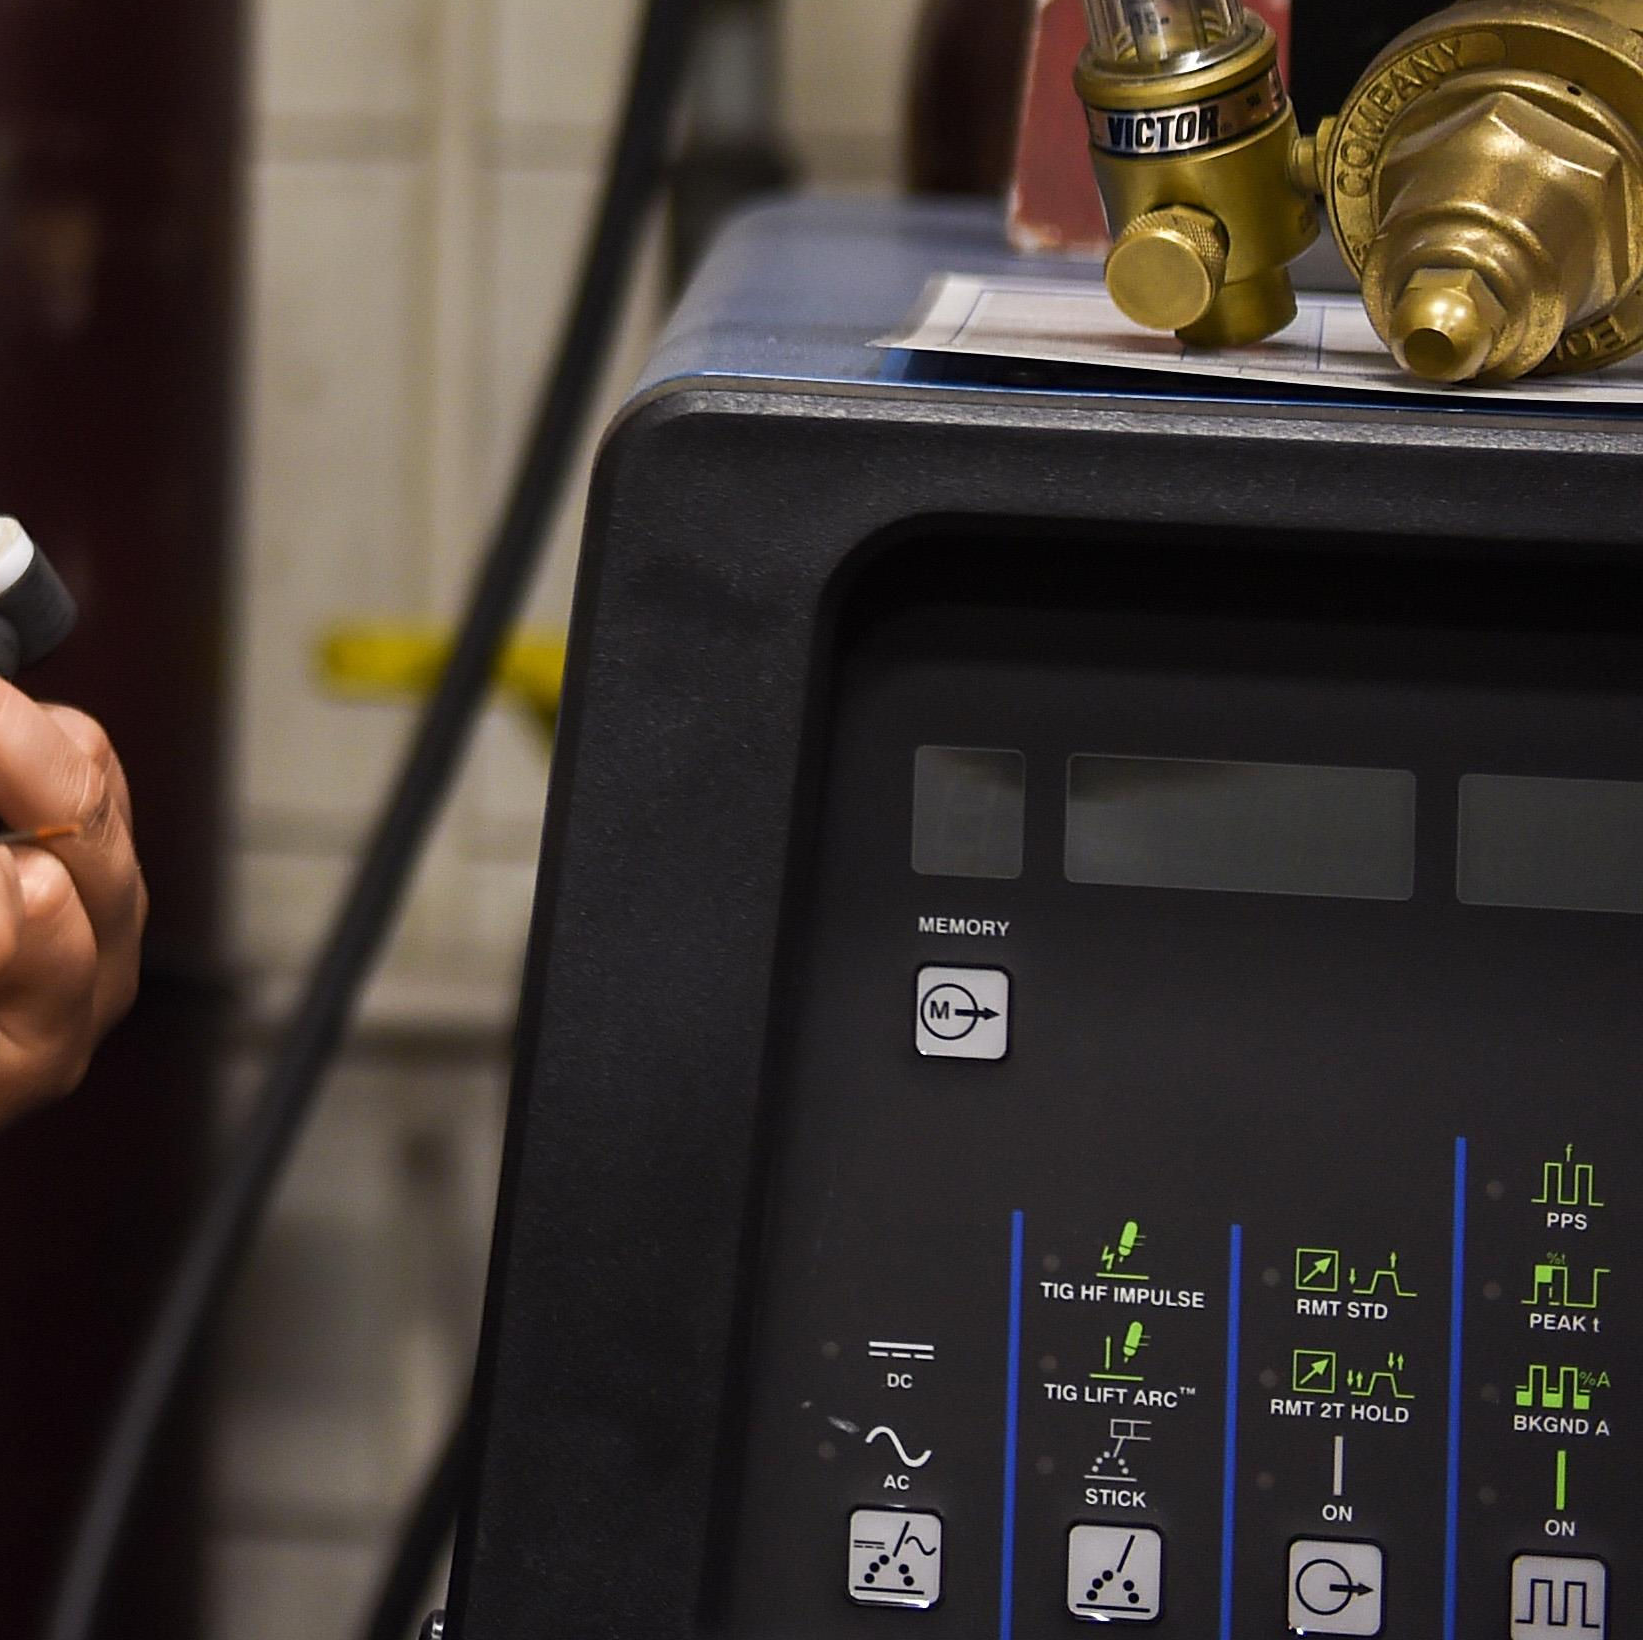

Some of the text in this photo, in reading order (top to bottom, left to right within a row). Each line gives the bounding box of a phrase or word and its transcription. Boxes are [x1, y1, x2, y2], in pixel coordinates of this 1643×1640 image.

[1107, 105, 1220, 149] VICTOR
[1336, 38, 1463, 198] COMPANY
[918, 916, 1010, 936] MEMORY
[930, 1000, 950, 1019] M
[1546, 1212, 1588, 1230] PPS
[1040, 1282, 1205, 1308] TIG HF IMPULSE
[1297, 1298, 1388, 1319] RMT STD
[1529, 1313, 1601, 1332] PEAK t
[887, 1373, 913, 1389] DC
[1044, 1383, 1077, 1401] TIG
[1084, 1386, 1128, 1404] LIFT
[1270, 1398, 1410, 1423] RMT 2T HOLD
[1514, 1414, 1610, 1436] BKGND A
[883, 1474, 911, 1490] AC
[1085, 1487, 1147, 1508] STICK
[1322, 1504, 1352, 1522] ON
[1544, 1519, 1576, 1537] ON
